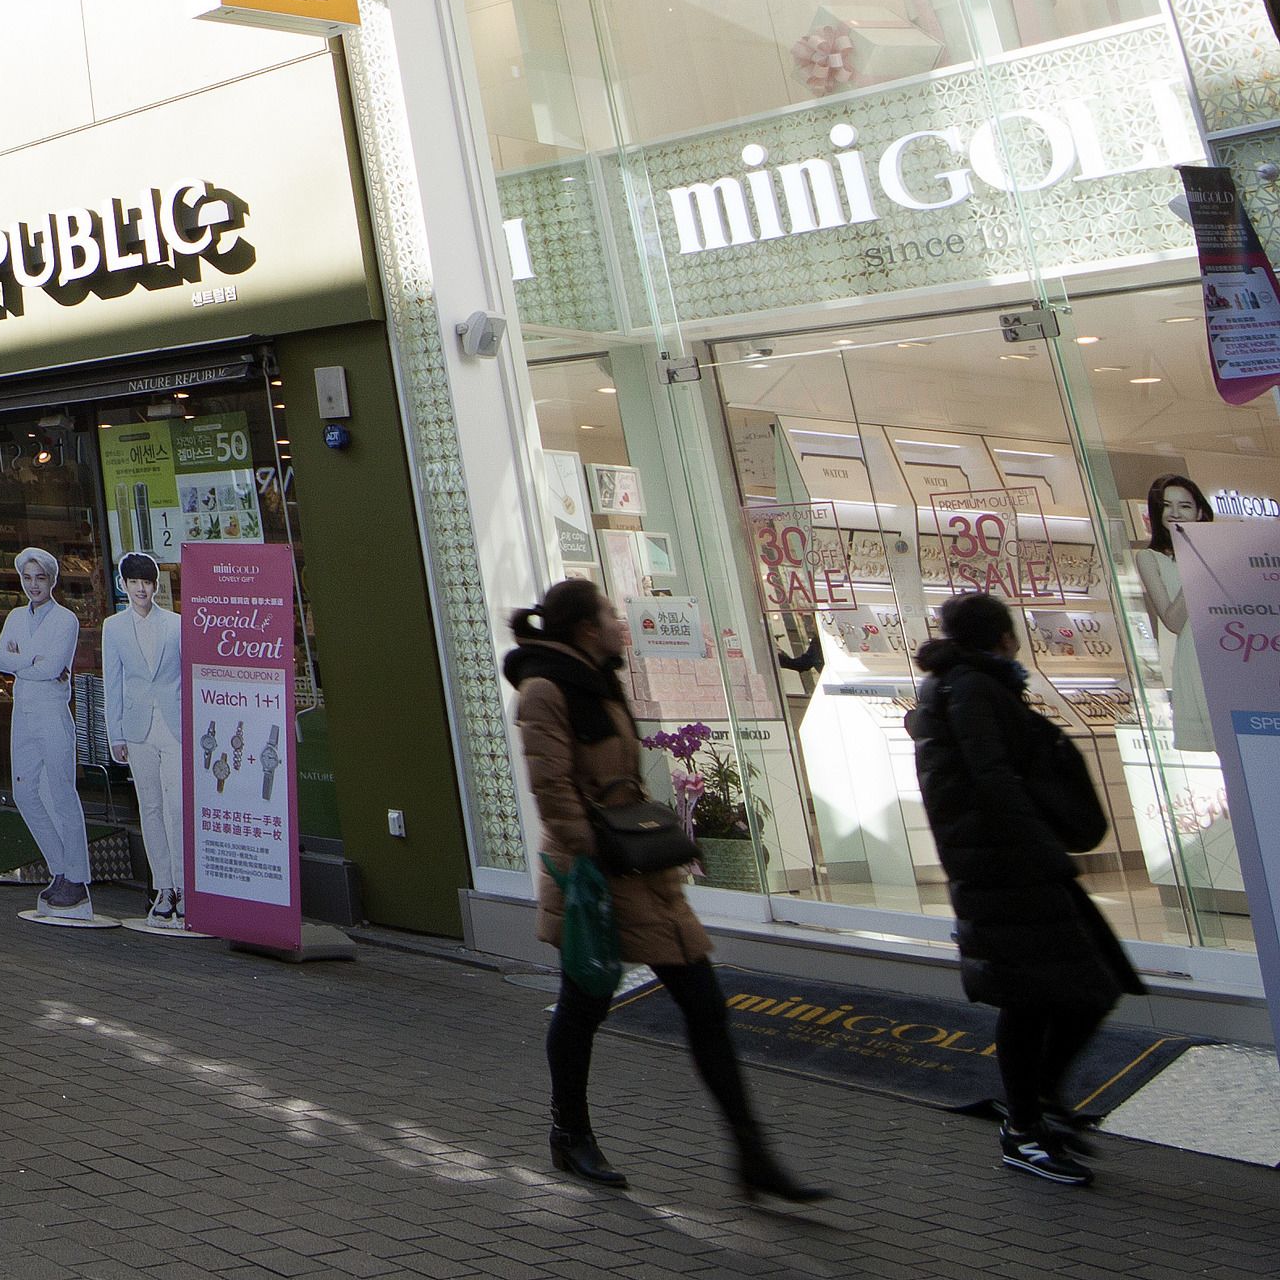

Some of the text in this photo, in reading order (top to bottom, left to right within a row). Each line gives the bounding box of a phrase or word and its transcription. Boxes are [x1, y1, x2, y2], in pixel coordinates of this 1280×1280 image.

[864, 214, 1051, 269] since 198
[191, 284, 238, 308] 센트럴점
[128, 374, 171, 392] NATURE
[129, 443, 169, 465] 에센스
[216, 430, 248, 462] 50
[938, 494, 1030, 512] PREMIUM OUTLET
[1215, 489, 1280, 518] miniGOLD
[792, 508, 829, 520] OUTLET
[806, 549, 838, 566] OFF
[213, 562, 260, 574] miniGOLD
[219, 575, 240, 583] LOVELY
[766, 569, 849, 606] SALE
[958, 560, 1055, 599] SALE
[191, 595, 229, 605] miniGOLD
[657, 611, 690, 624] 外国人
[1208, 603, 1280, 616] miniGOL
[193, 606, 259, 634] Special
[659, 624, 691, 637] 免税店
[217, 629, 284, 659] Event
[200, 667, 280, 681] SPECIAL COUPON 2
[201, 687, 281, 710] Watch 1+1
[299, 771, 335, 783] NATURE
